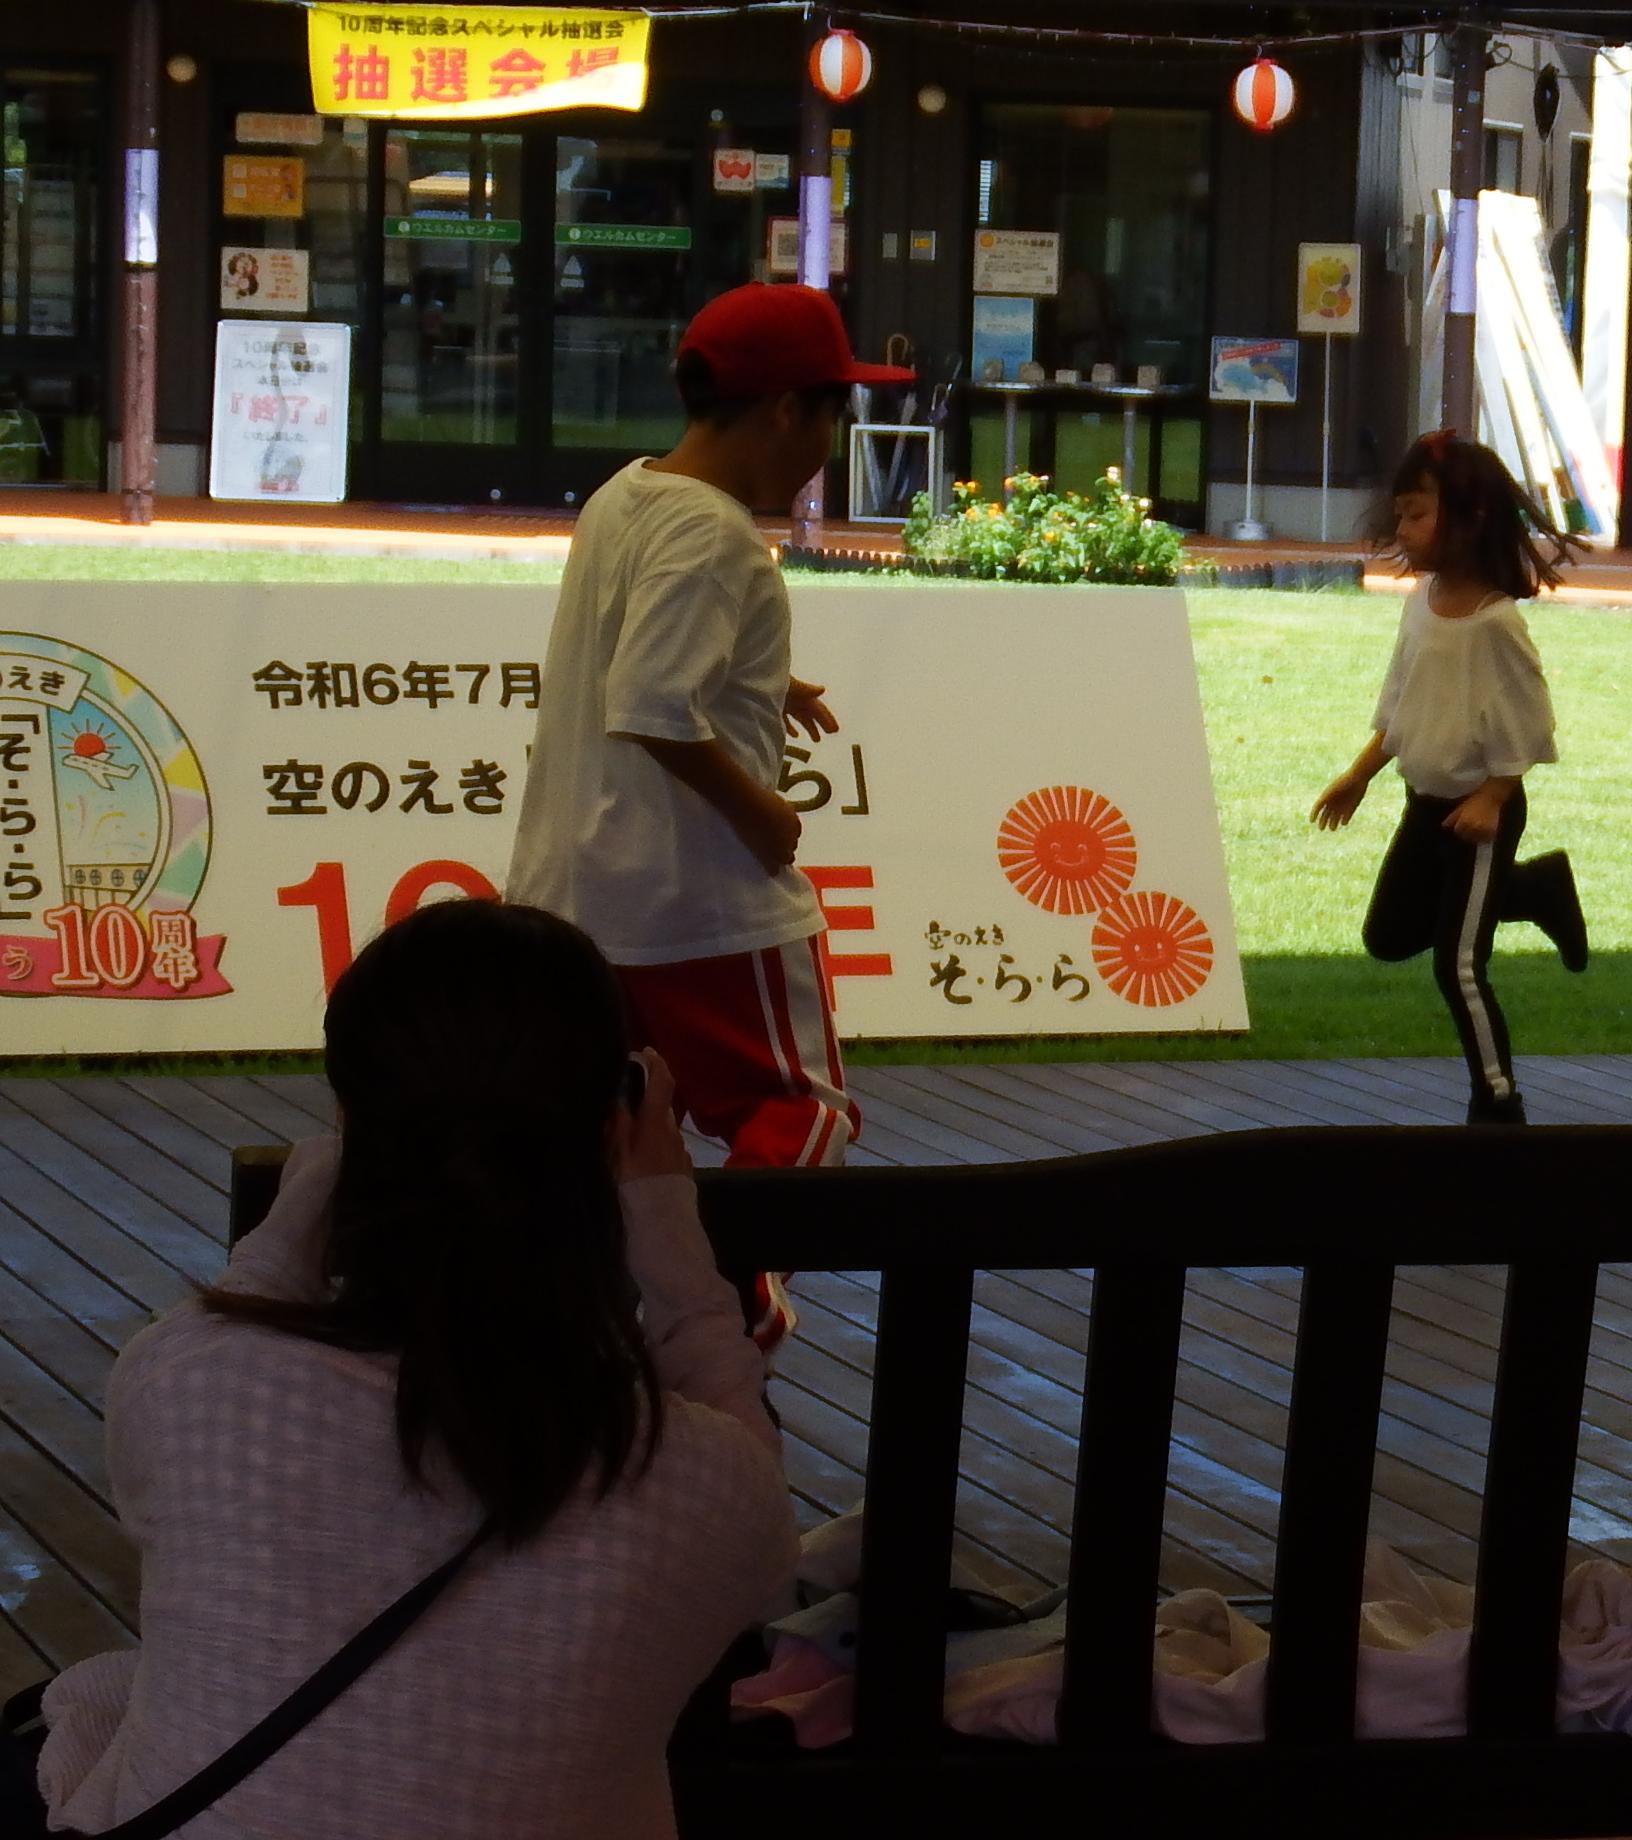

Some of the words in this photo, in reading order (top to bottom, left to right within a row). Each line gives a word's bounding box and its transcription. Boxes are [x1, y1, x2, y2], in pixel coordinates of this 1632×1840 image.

[338, 14, 625, 40] 10周年記念スペシャル抽選会
[0, 664, 66, 697] えき
[252, 660, 541, 709] 令和6年7月
